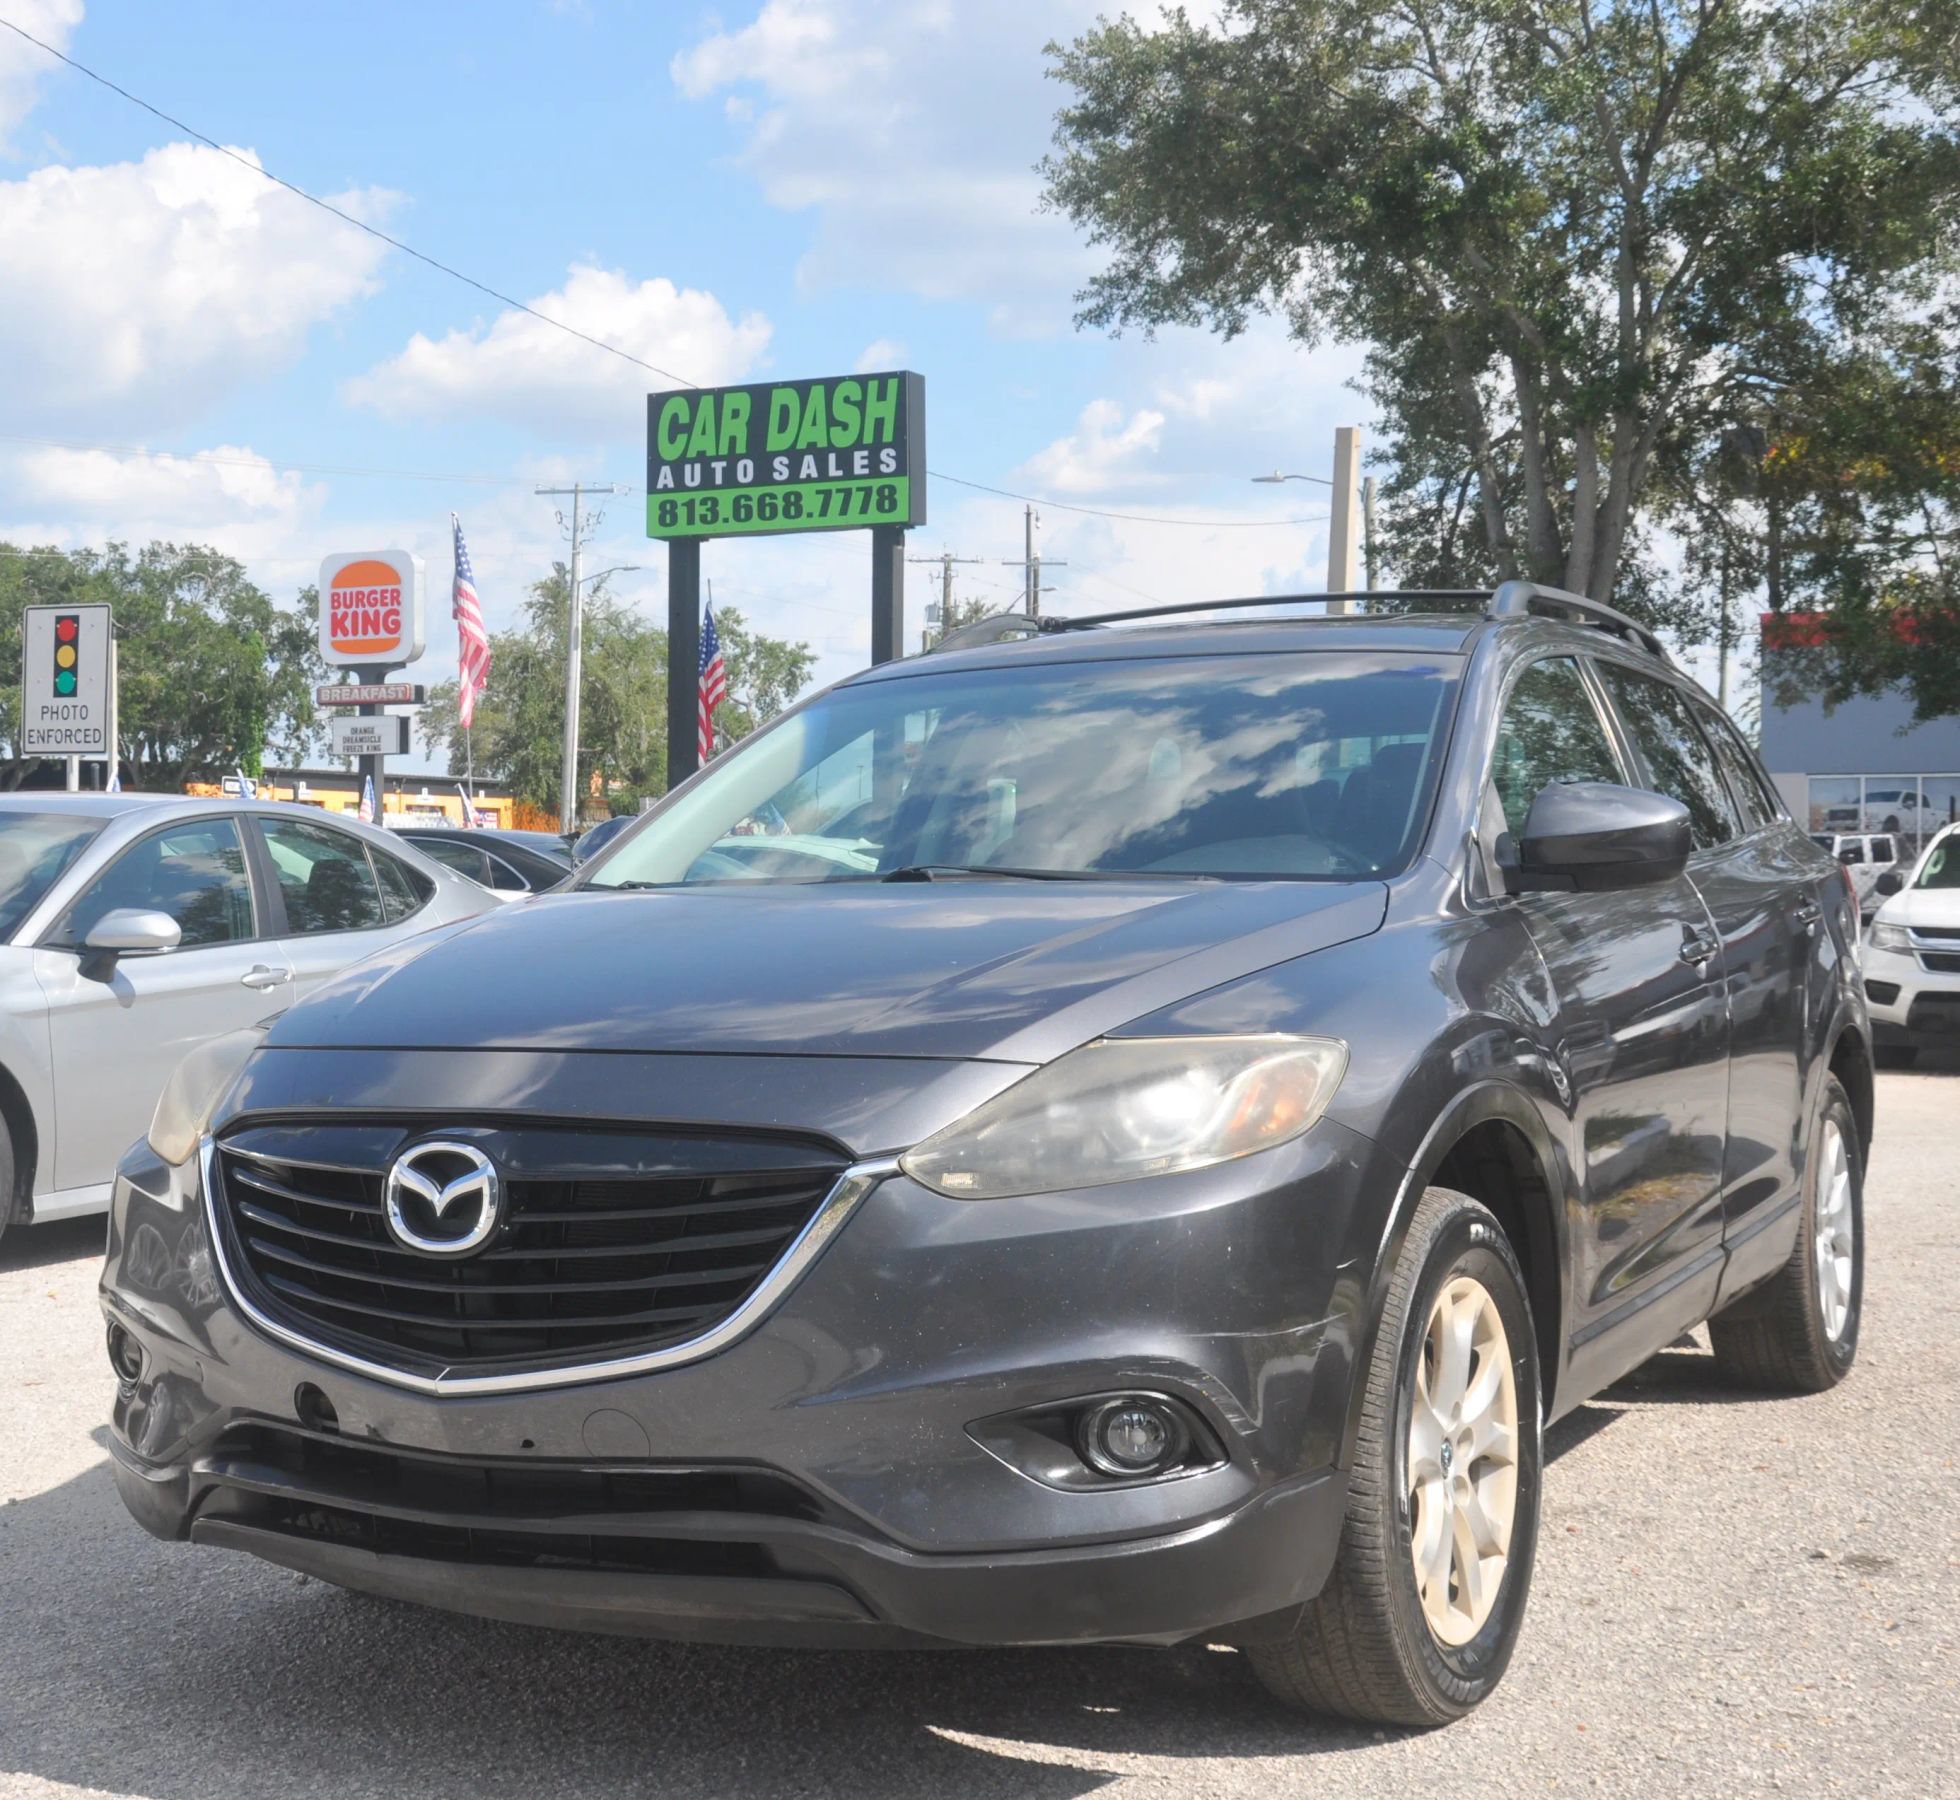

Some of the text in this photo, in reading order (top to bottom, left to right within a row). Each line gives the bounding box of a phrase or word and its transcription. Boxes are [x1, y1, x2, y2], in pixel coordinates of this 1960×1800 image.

[656, 378, 899, 461] CAR DASH
[656, 447, 897, 489] AUTO SALES
[658, 484, 898, 528] 813.668.7778
[331, 588, 401, 610] BURGER
[330, 608, 401, 638] KING
[320, 686, 405, 701] BREAKFAST
[40, 704, 89, 720] PHOTO
[27, 728, 102, 744] ENFORCED
[350, 726, 375, 735] ORANGE
[366, 744, 381, 752] KING
